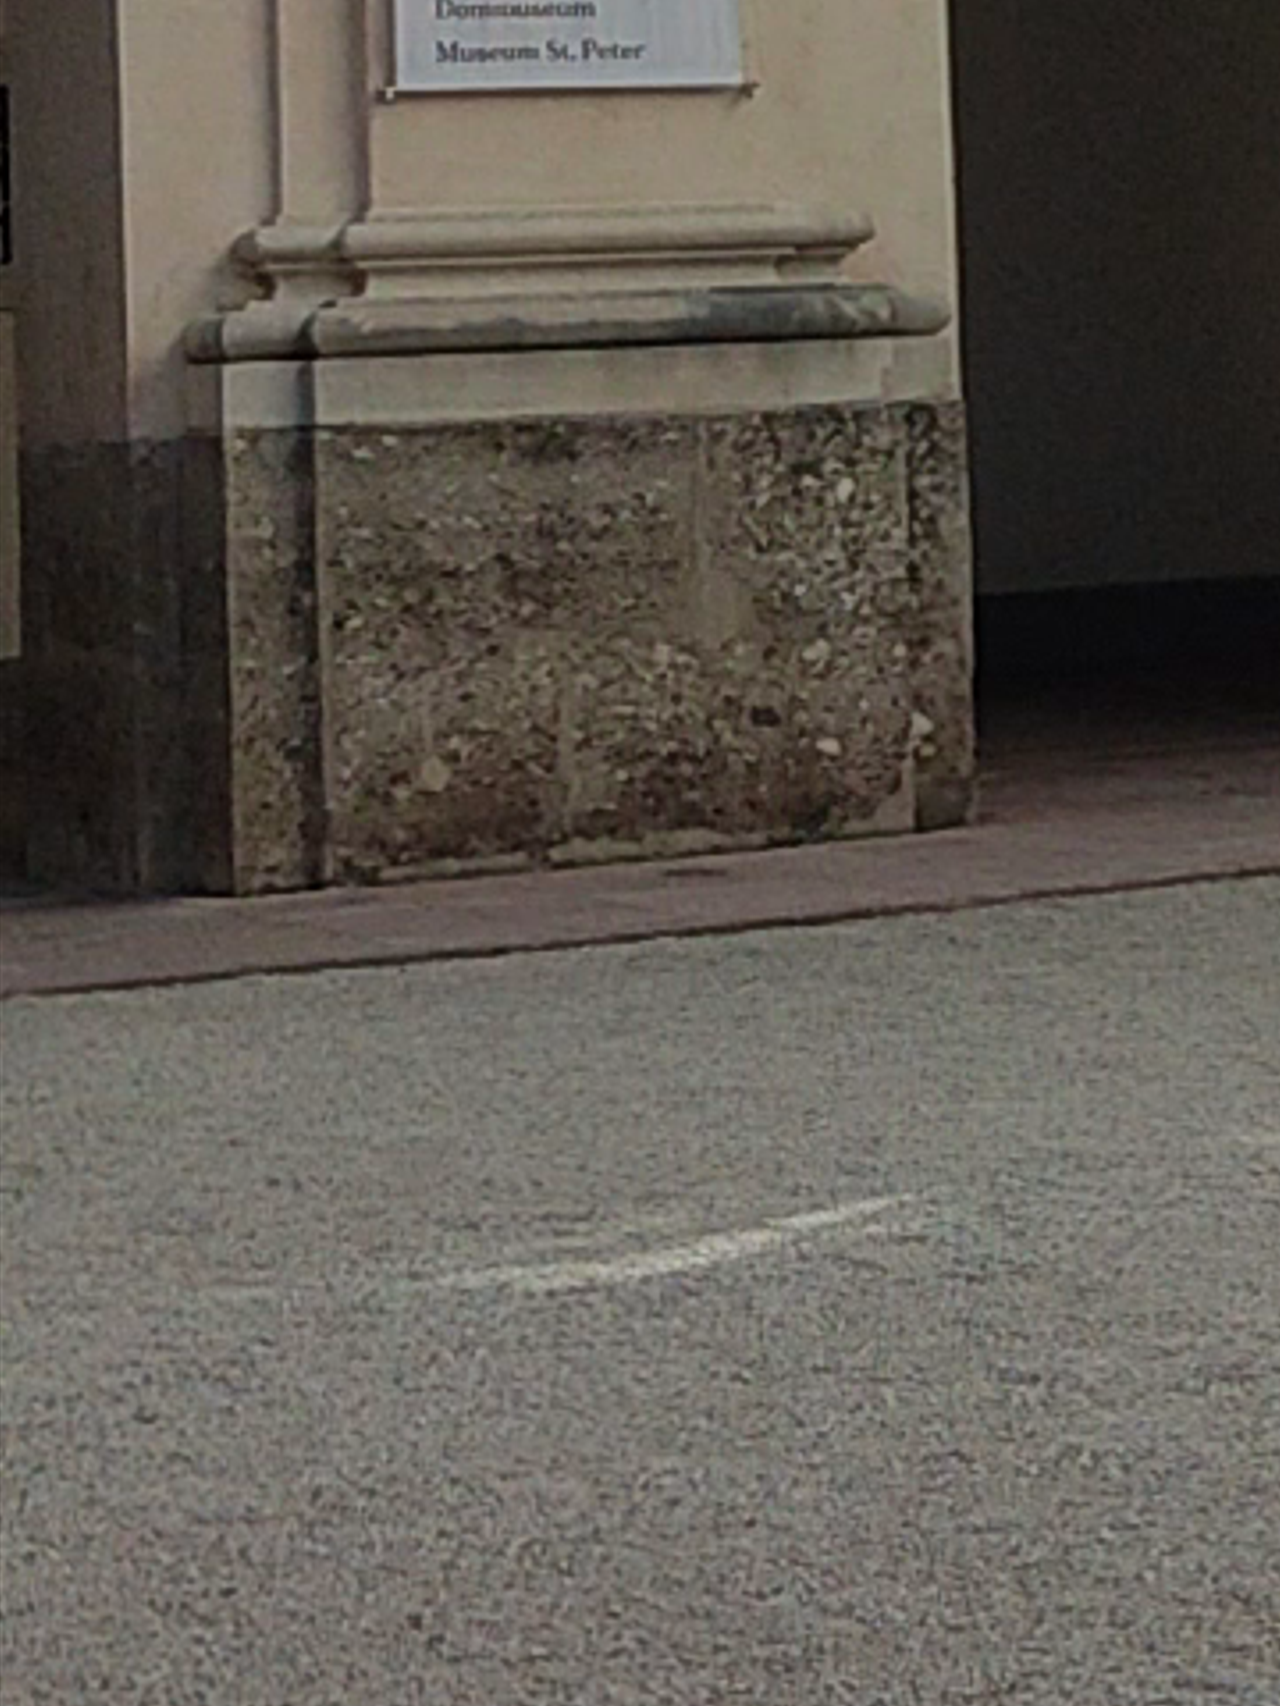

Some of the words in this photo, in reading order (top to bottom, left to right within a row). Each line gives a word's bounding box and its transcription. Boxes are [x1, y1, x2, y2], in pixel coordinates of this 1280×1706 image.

[436, 40, 540, 63] Museum
[546, 39, 577, 62] St.
[581, 38, 645, 62] Peter
